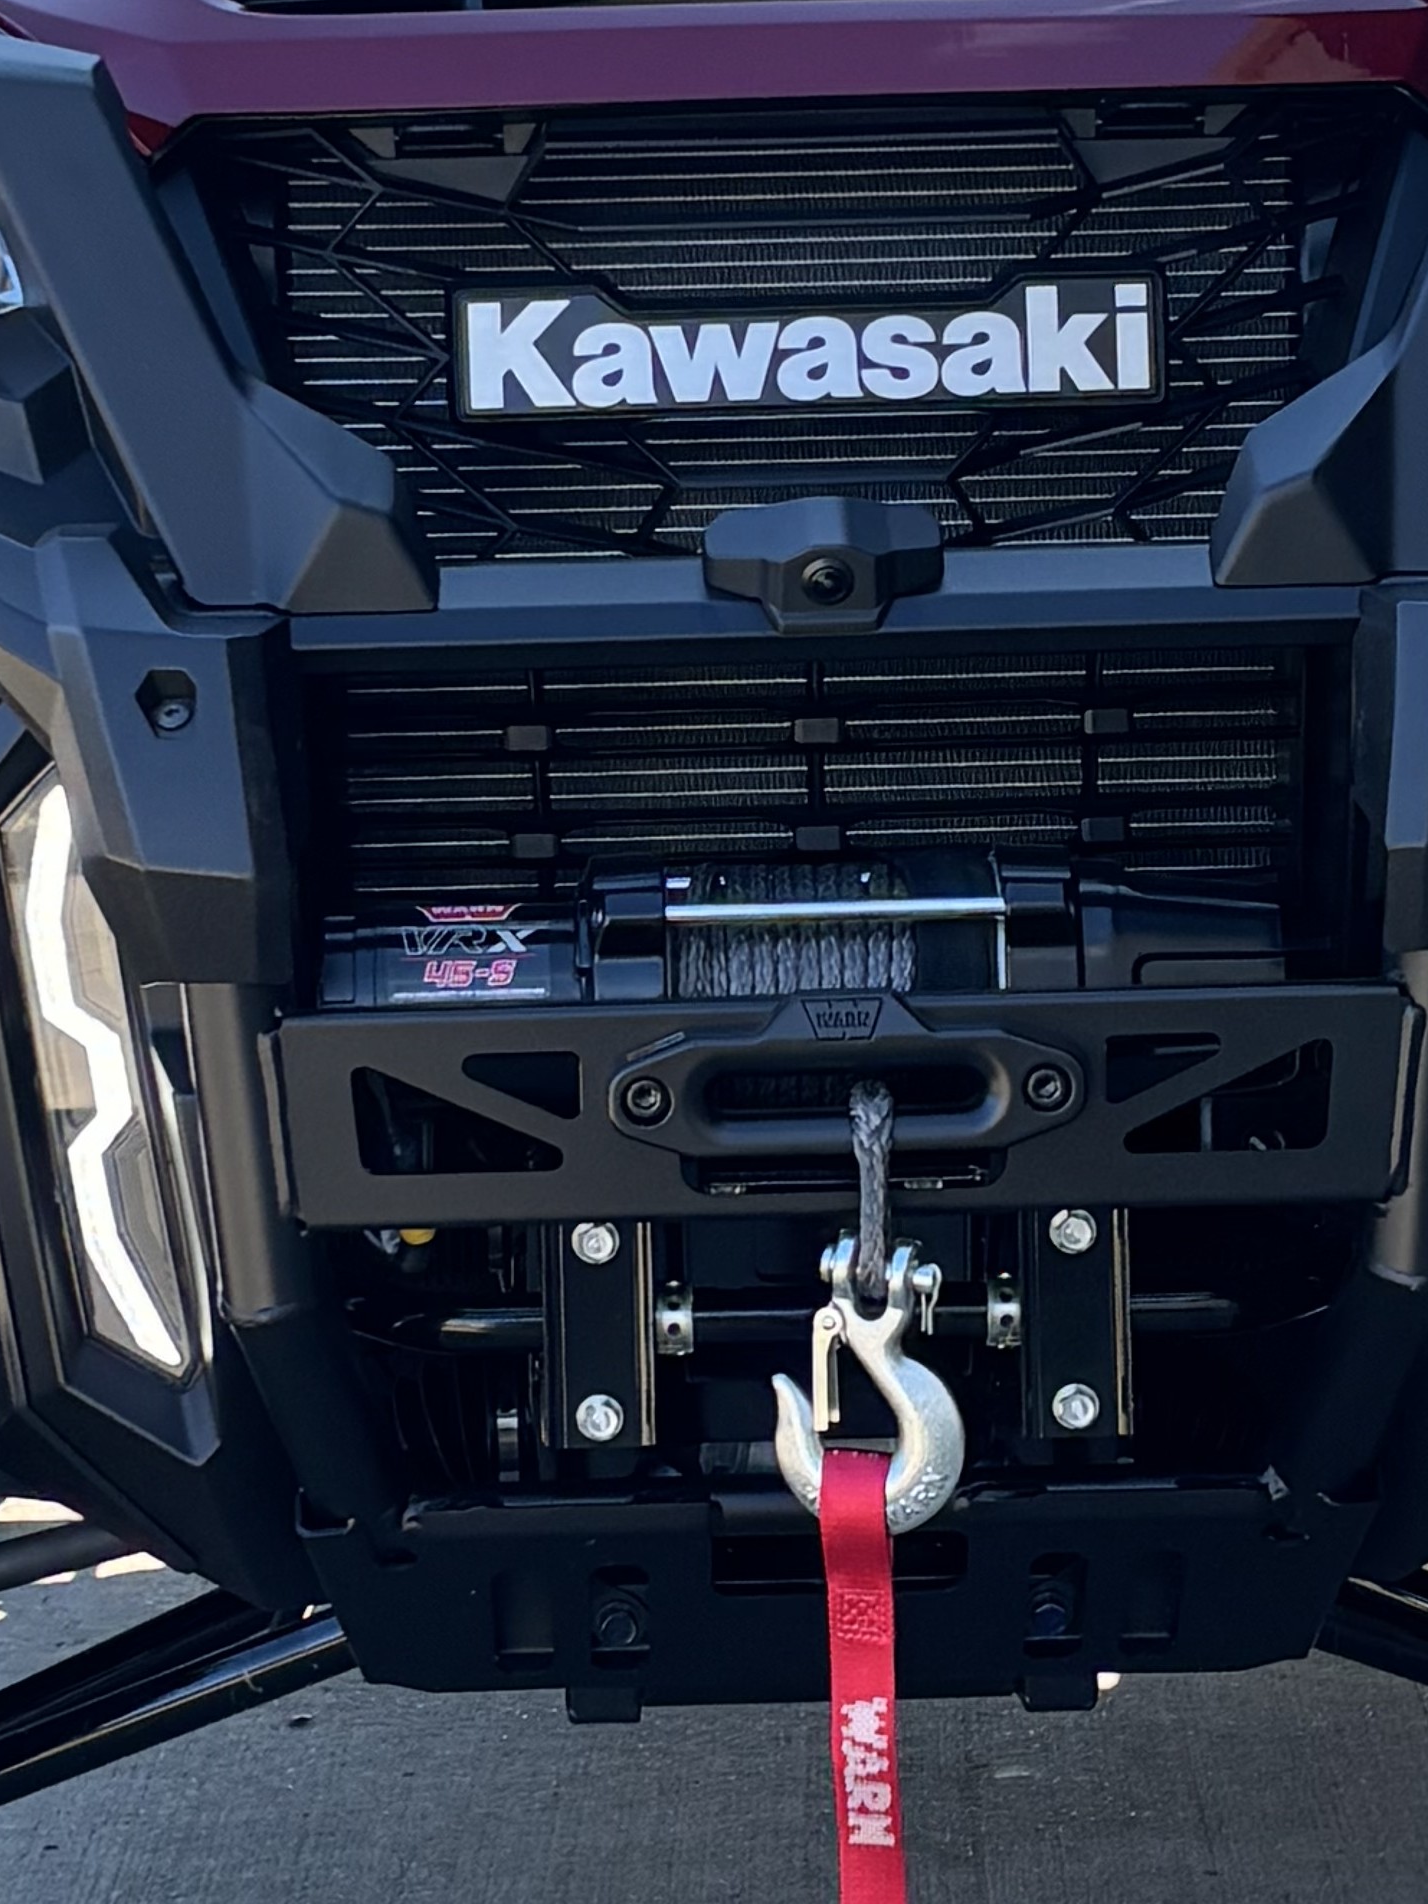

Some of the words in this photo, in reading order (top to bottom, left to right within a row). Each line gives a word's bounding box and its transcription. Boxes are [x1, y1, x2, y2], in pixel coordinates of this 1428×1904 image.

[467, 283, 1150, 410] Kawasaki
[401, 925, 537, 956] VRX
[840, 1697, 895, 1847] WARN
